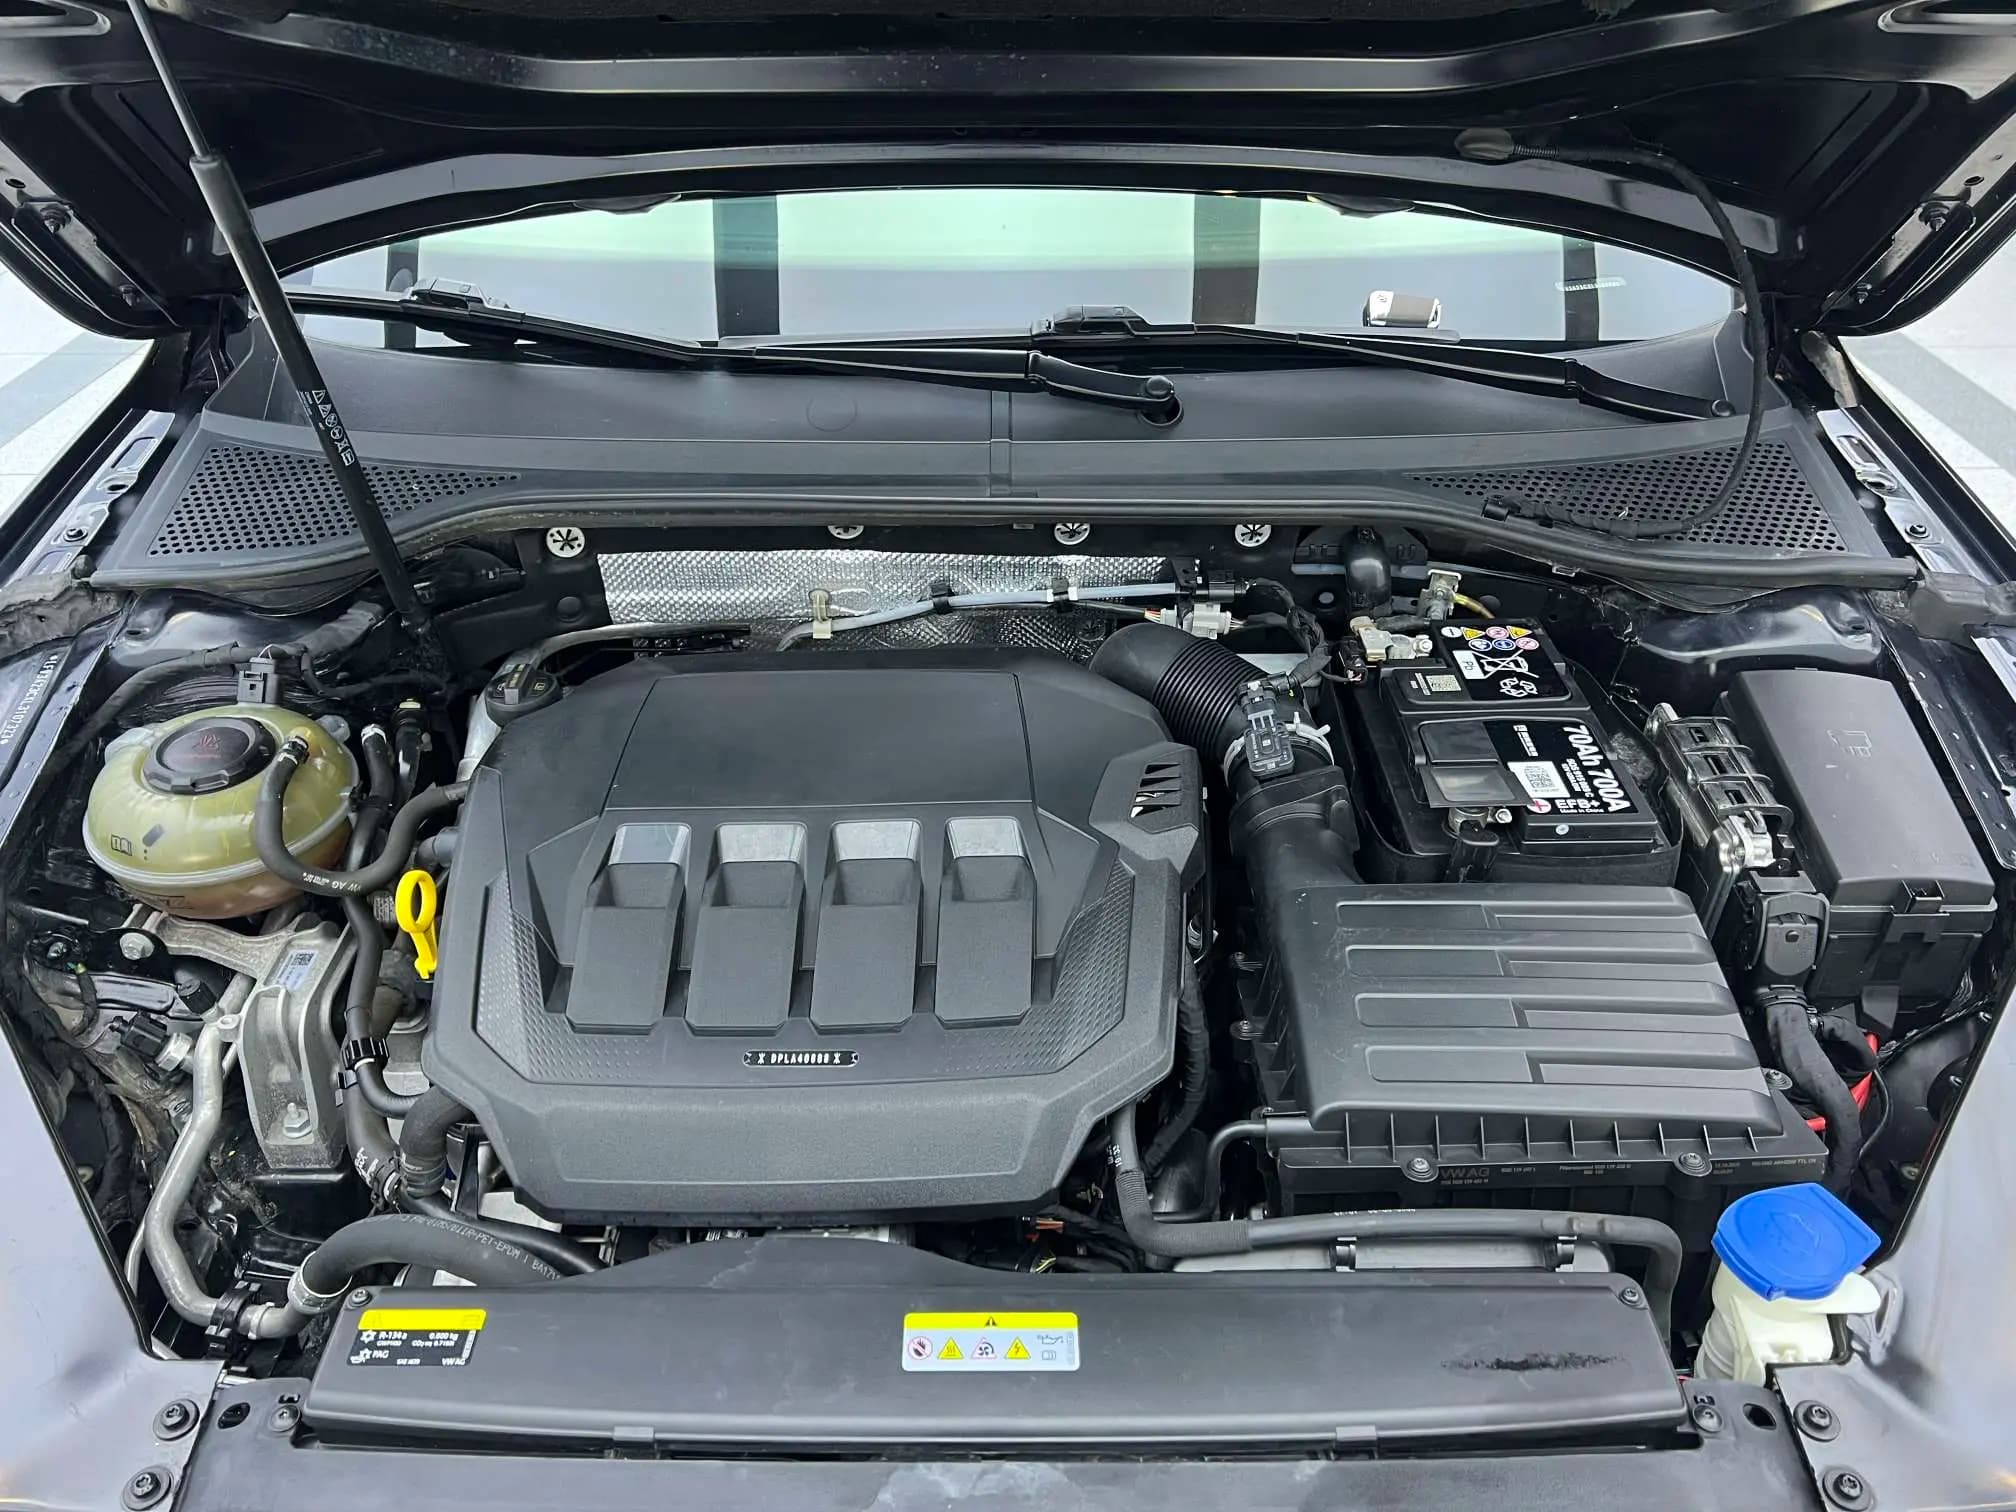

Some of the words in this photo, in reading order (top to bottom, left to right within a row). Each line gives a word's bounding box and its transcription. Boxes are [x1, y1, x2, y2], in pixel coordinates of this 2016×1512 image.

[1460, 660, 1475, 671] Pb
[1562, 725, 1604, 766] 70Ah
[1587, 768, 1631, 812] 700A
[372, 1350, 389, 1359] PAG
